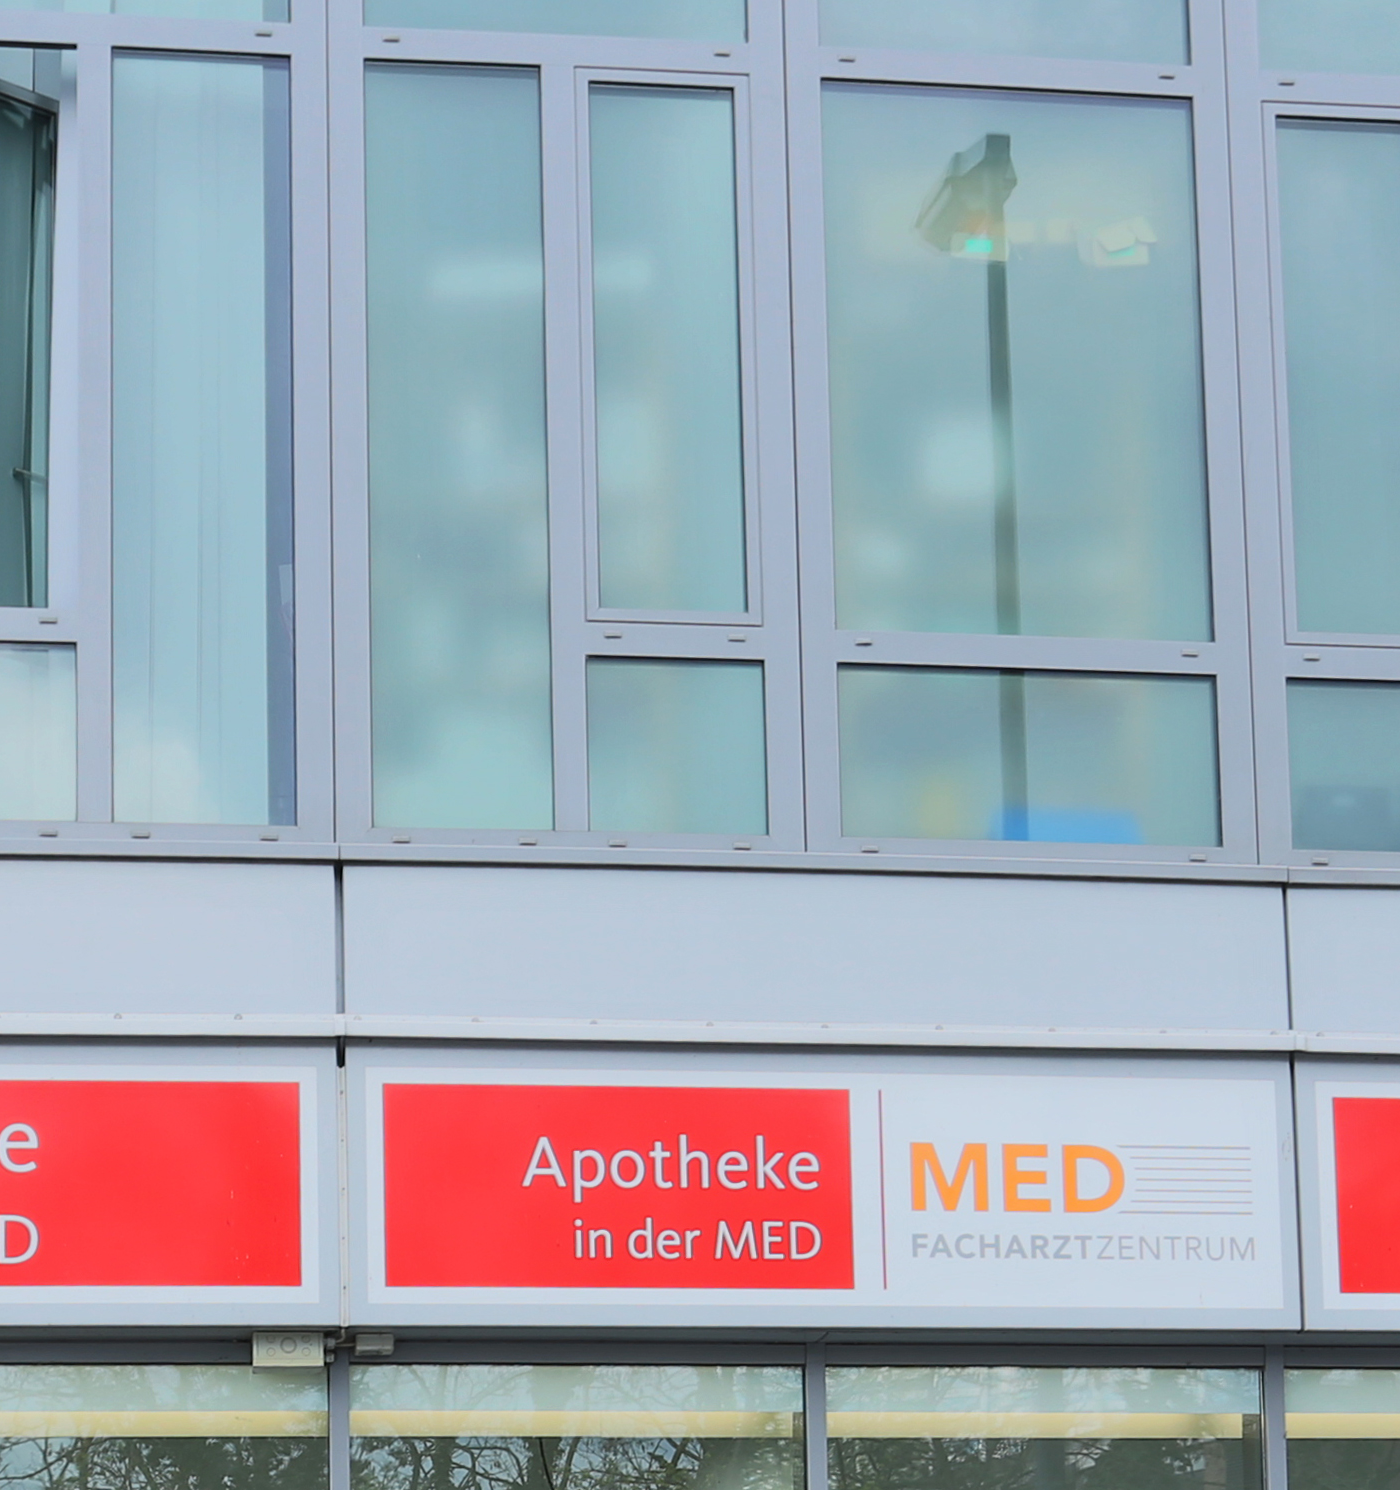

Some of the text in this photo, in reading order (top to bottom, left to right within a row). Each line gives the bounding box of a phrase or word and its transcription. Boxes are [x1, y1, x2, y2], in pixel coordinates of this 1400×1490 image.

[521, 1134, 820, 1203] Apotheke
[909, 1141, 1125, 1213] MED
[573, 1217, 822, 1260] in der MED
[910, 1232, 1256, 1262] FACHARZTZENTRUM
